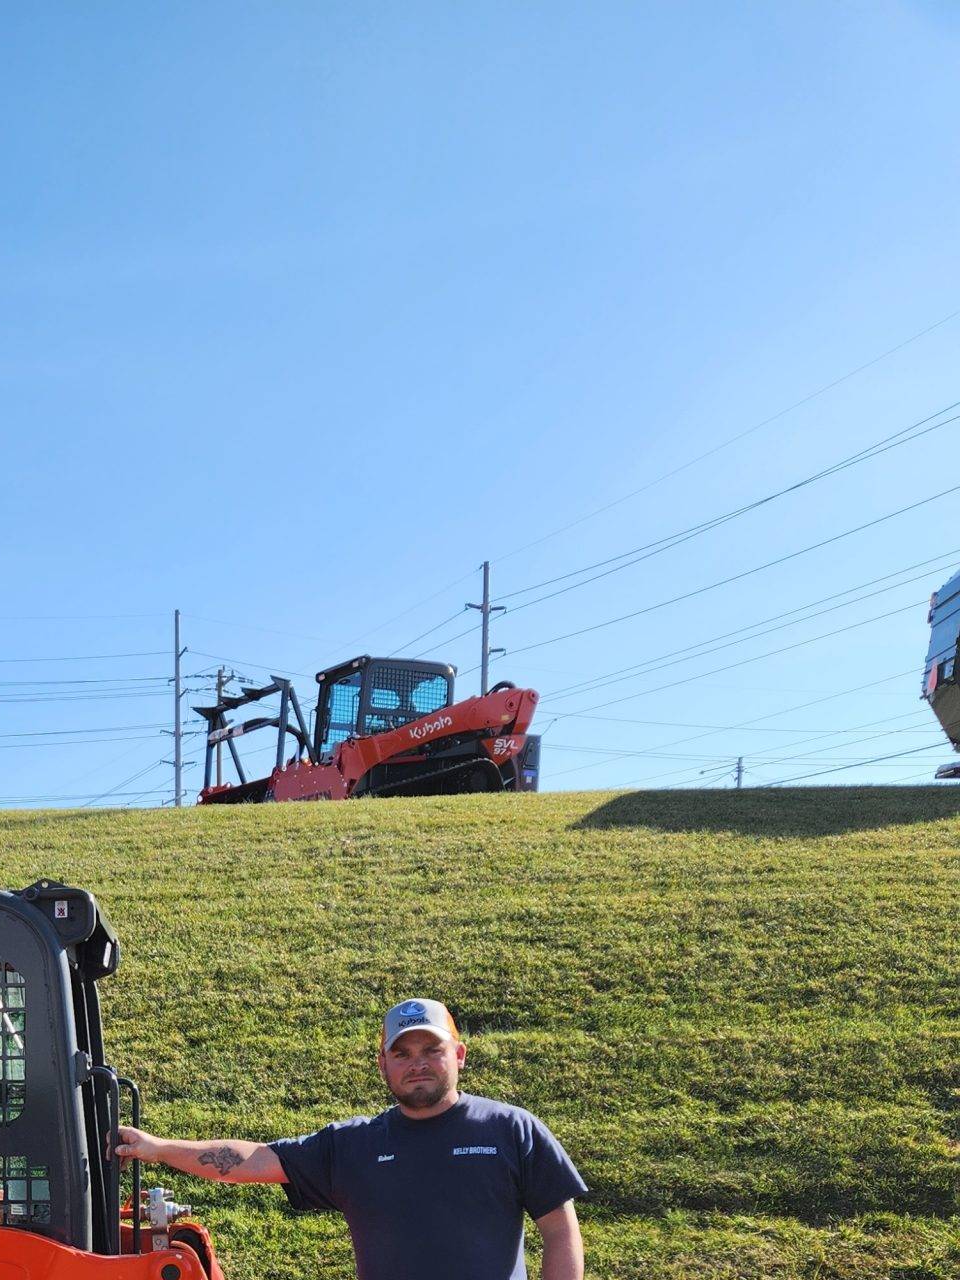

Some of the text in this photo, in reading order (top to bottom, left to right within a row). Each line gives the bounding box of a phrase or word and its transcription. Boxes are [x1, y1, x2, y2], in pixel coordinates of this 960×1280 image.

[409, 716, 452, 739] Kubota
[494, 738, 518, 749] SVL
[453, 1146, 498, 1156] KELLY BROTHERS
